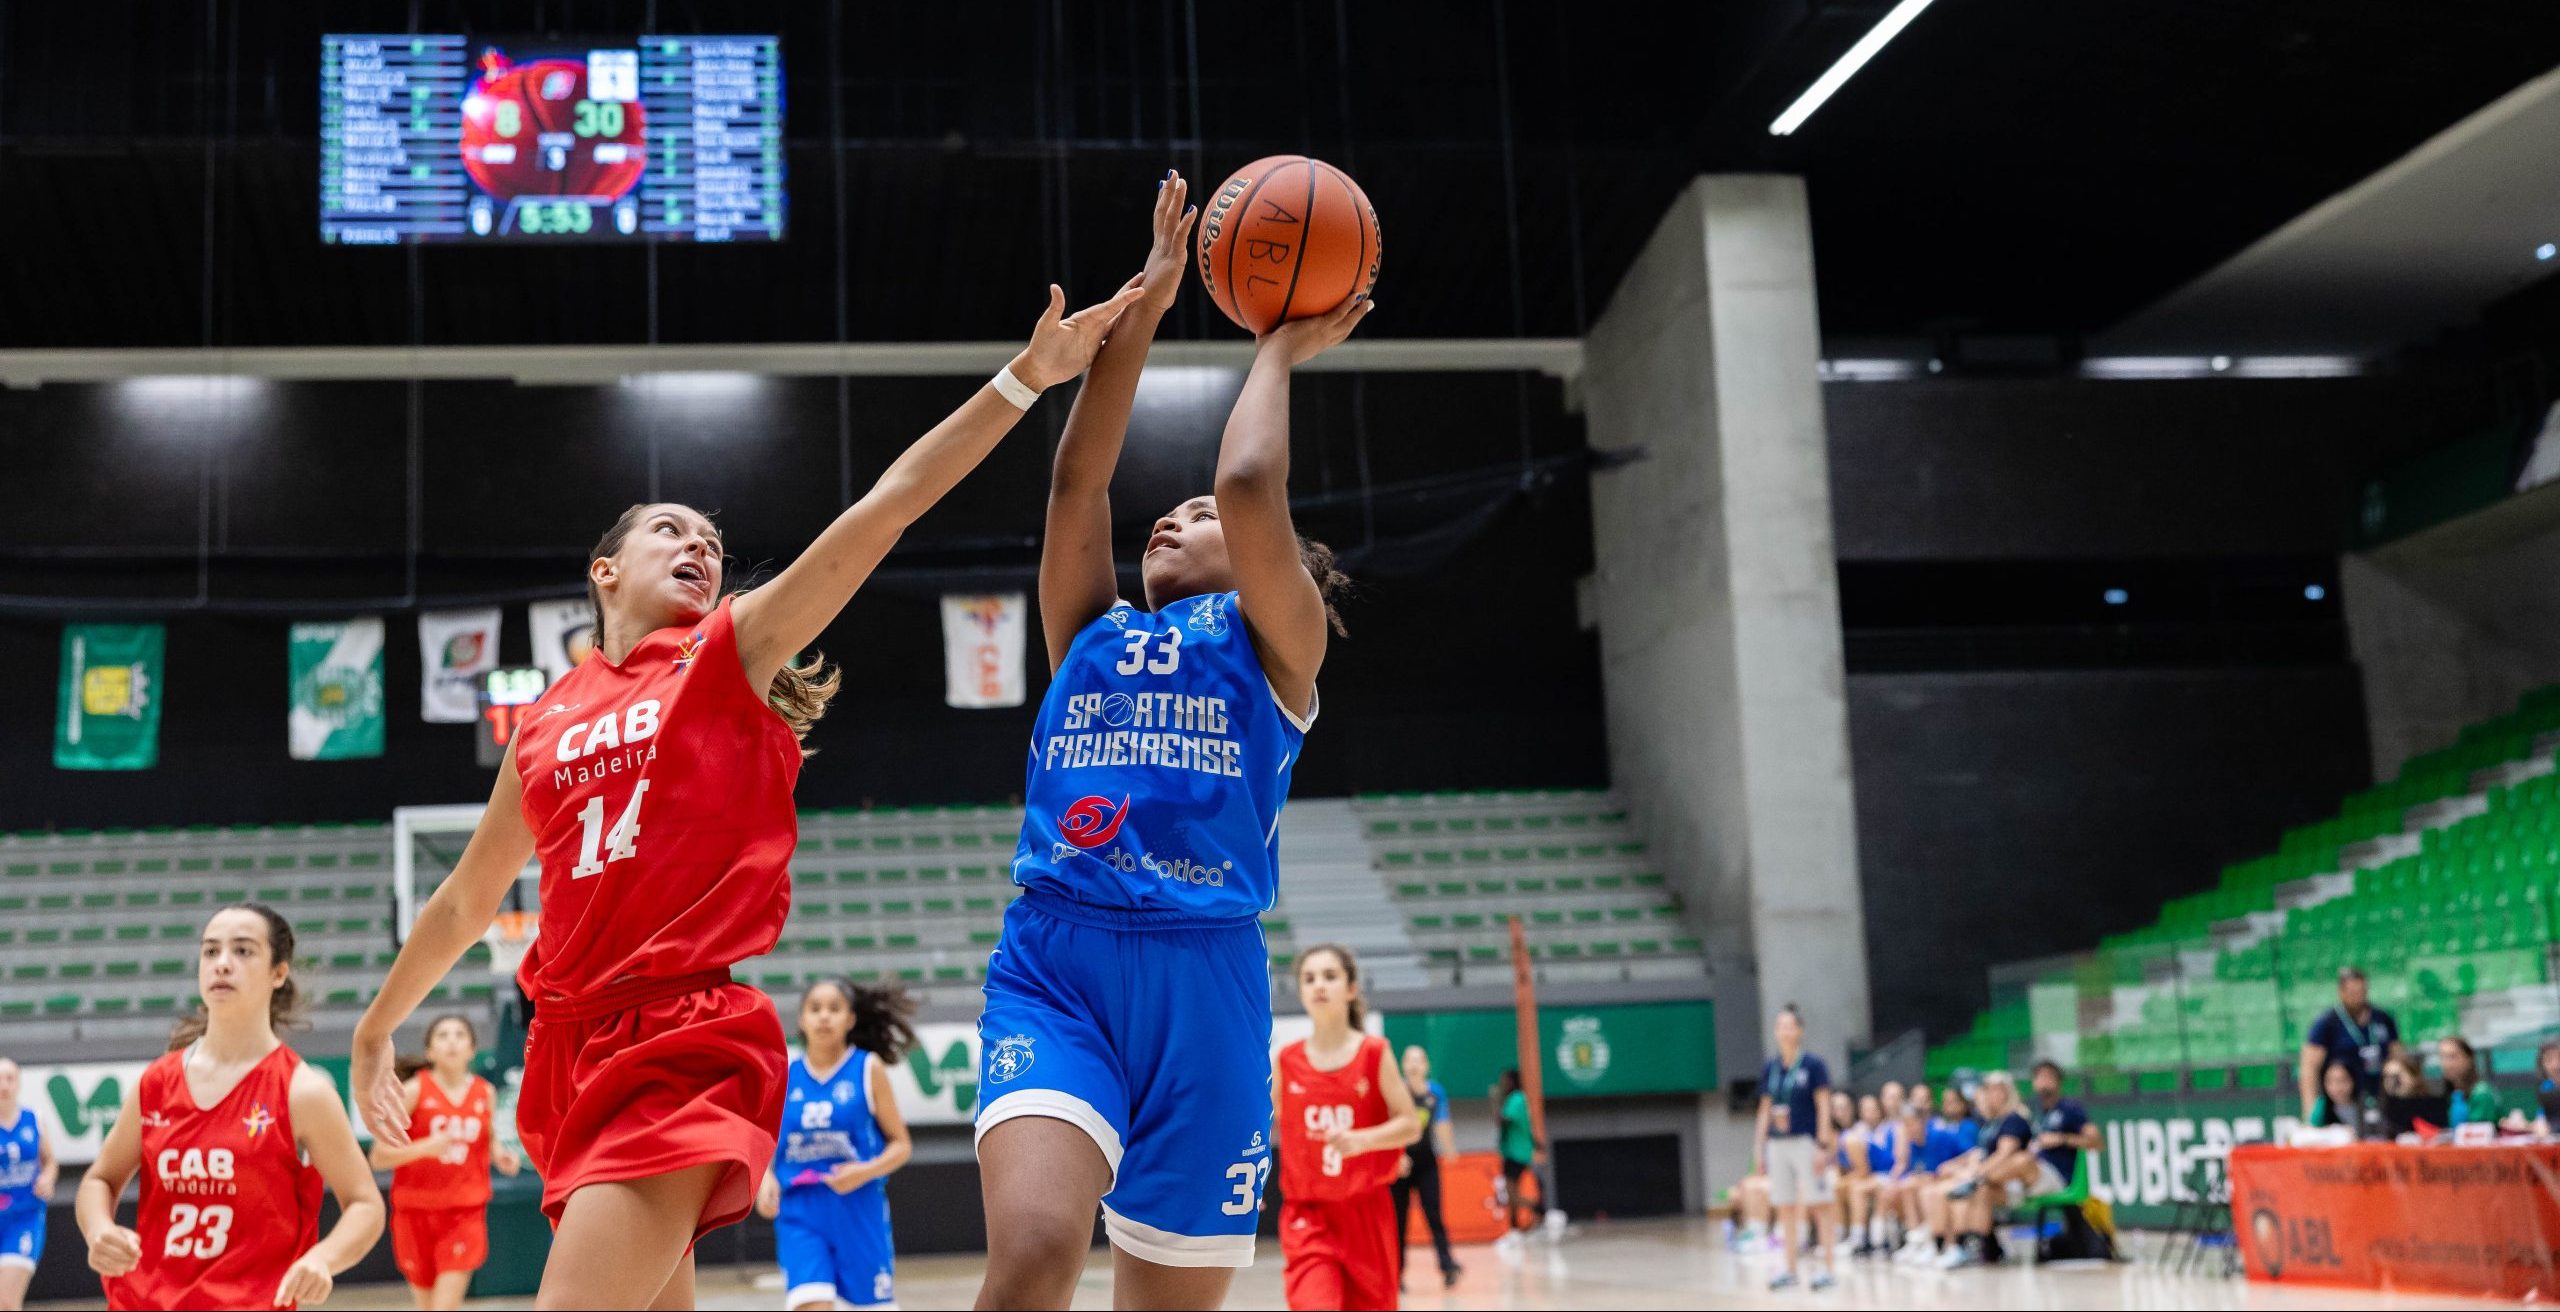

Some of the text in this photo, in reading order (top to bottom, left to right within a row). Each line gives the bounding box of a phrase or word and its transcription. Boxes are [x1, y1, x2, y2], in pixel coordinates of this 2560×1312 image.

[573, 99, 625, 138] 30
[1202, 177, 1252, 293] Wilson
[1116, 626, 1183, 676] 33
[556, 699, 661, 763] CAB
[1045, 730, 1242, 778] FIGUEIRENSE
[553, 744, 657, 790] Madeira
[571, 778, 651, 880] 14
[1304, 1103, 1355, 1132] CAB
[157, 1147, 235, 1181] CAB
[162, 1177, 238, 1196] Madeira
[164, 1202, 235, 1260] 23
